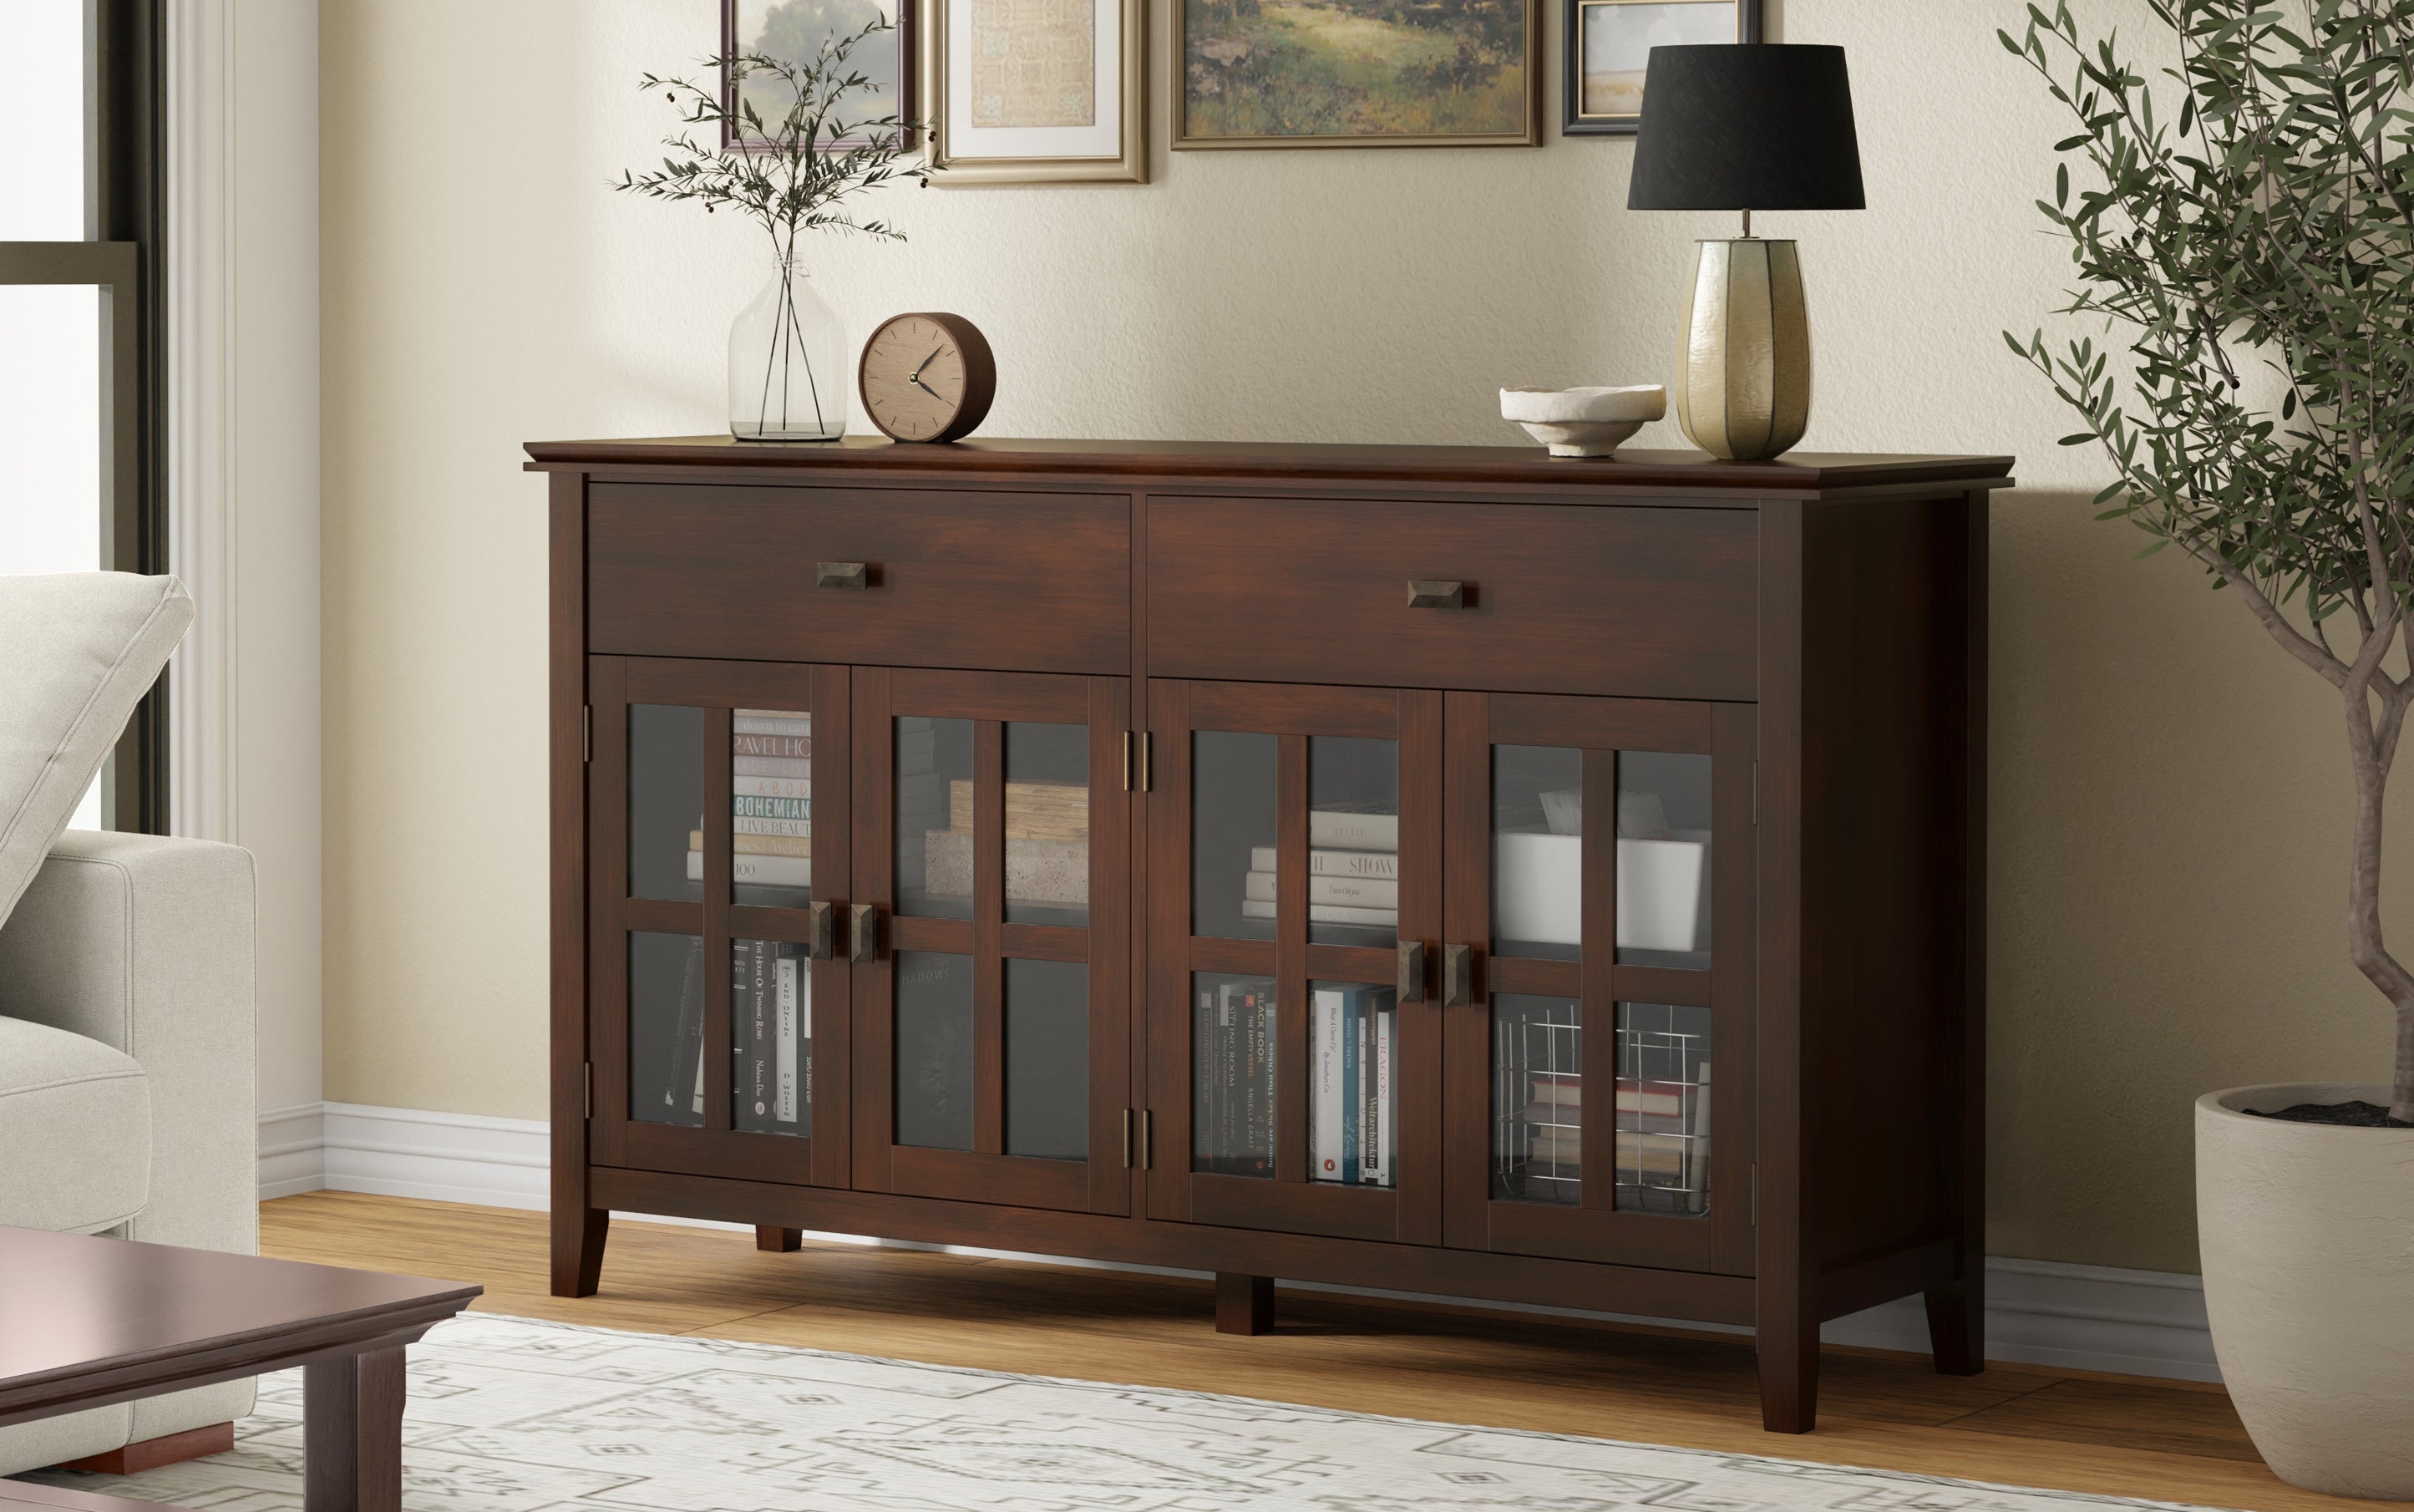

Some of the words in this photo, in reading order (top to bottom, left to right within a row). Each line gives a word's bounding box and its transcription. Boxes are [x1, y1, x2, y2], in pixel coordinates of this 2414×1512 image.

[736, 796, 810, 819] BOHEMIAN
[741, 819, 768, 834] LIVE
[1369, 1096, 1377, 1170] Weltarchitektur
